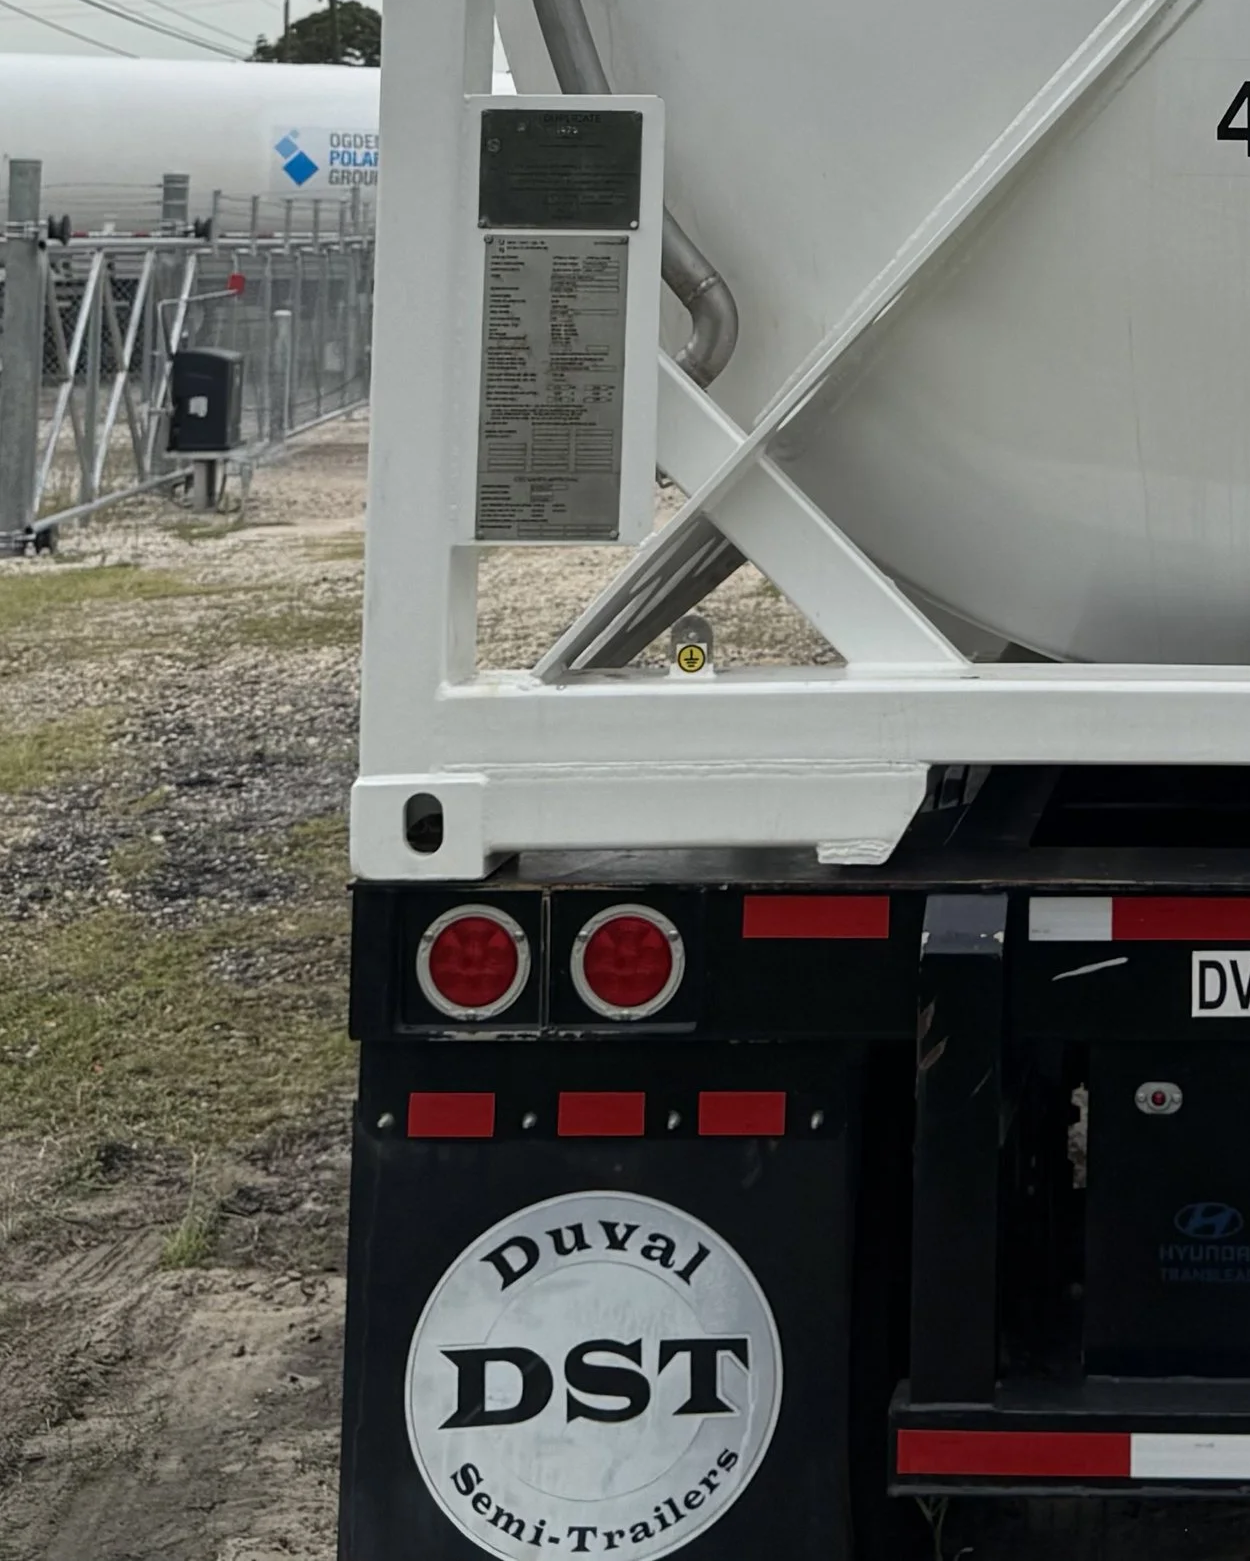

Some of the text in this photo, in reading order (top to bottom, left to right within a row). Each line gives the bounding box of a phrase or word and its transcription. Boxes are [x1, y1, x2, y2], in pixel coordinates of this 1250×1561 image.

[328, 169, 379, 186] GROU
[479, 1220, 712, 1291] Duval
[438, 1337, 750, 1430] DST
[450, 1447, 739, 1553] Semi-Trailers
